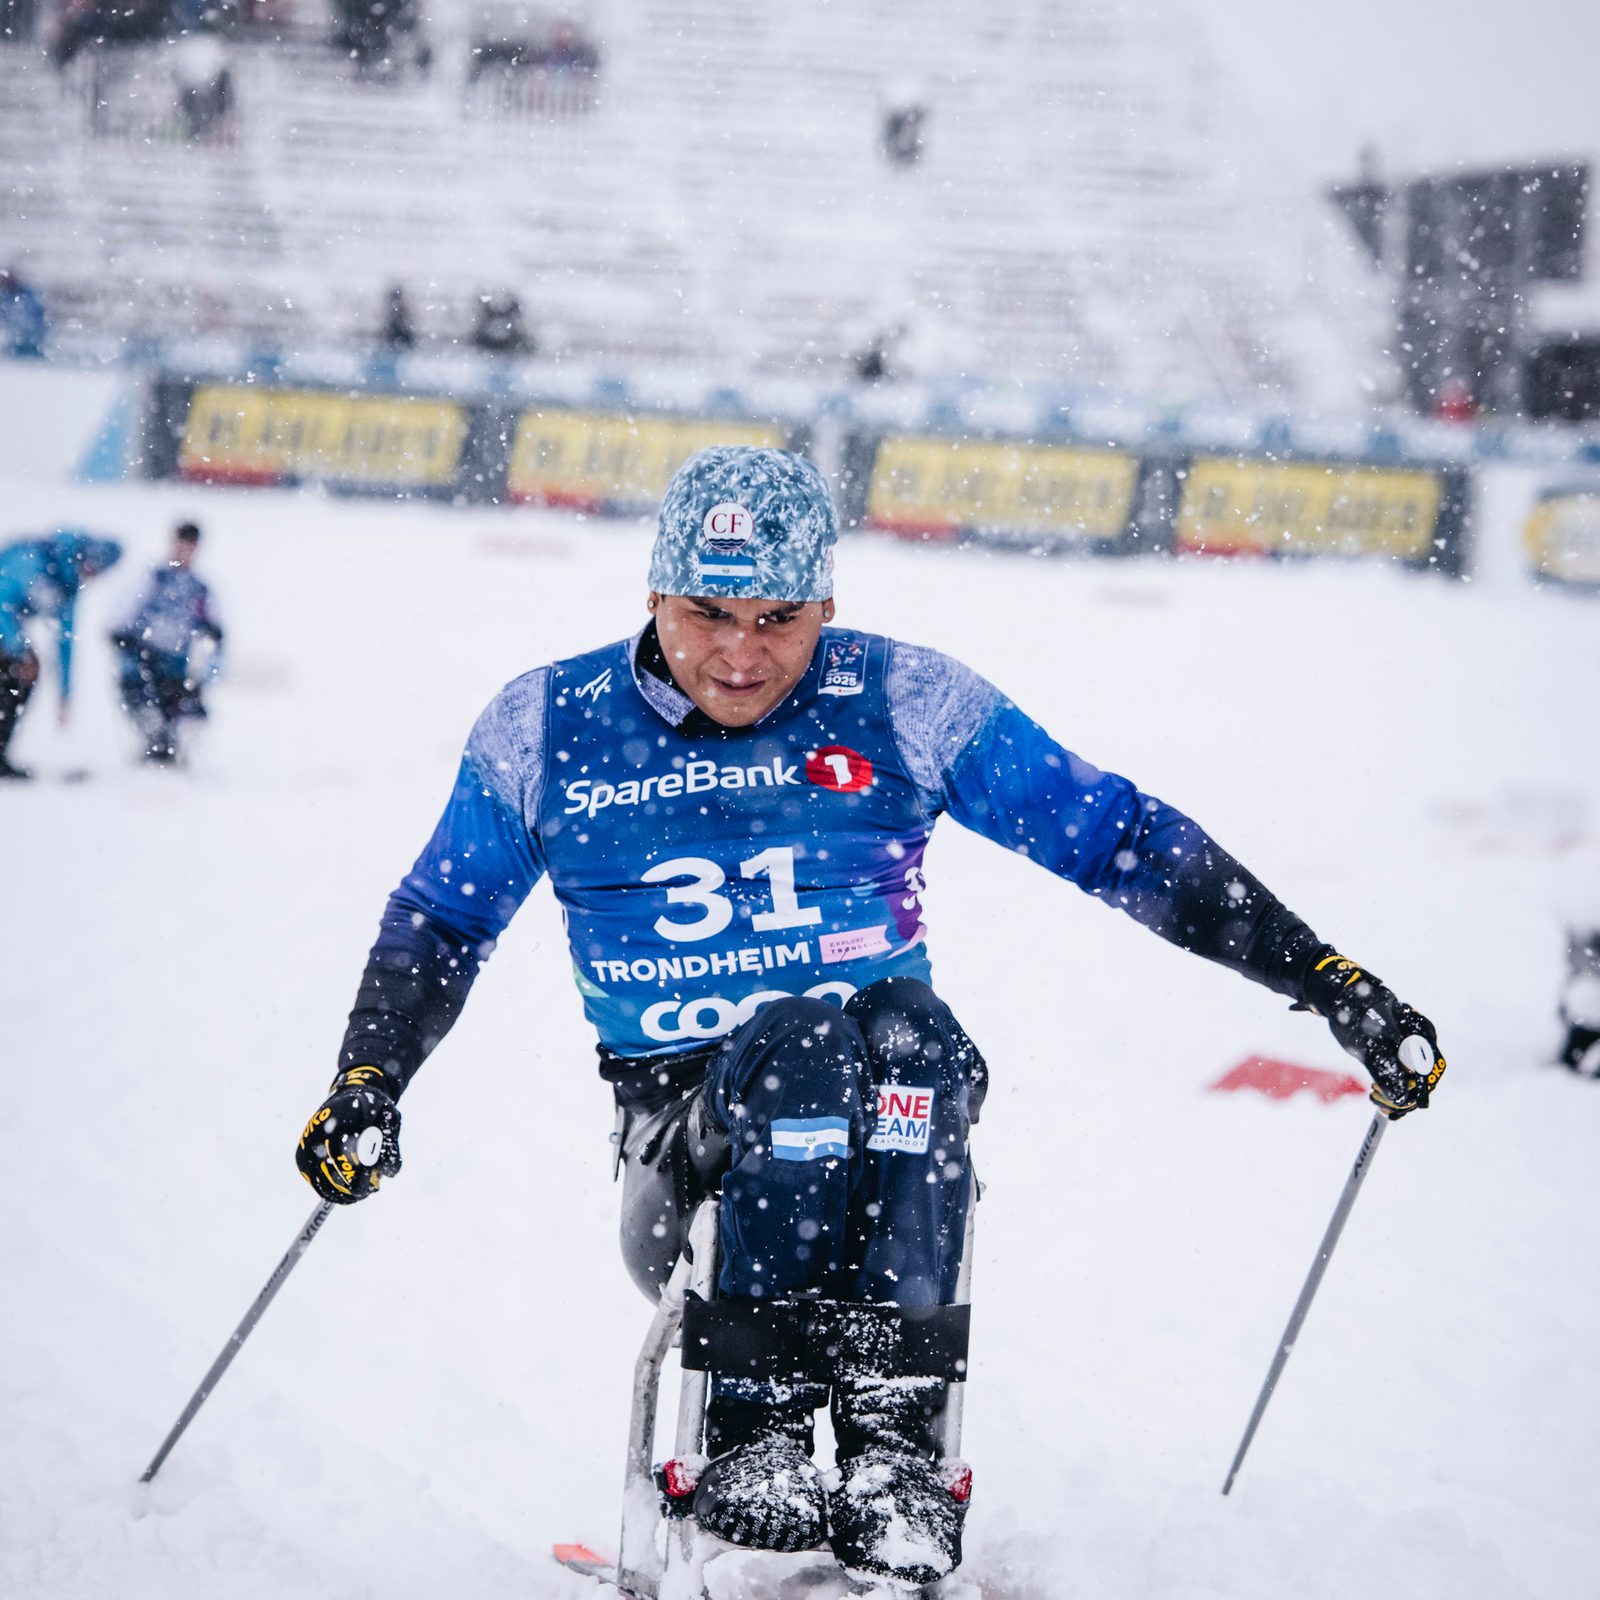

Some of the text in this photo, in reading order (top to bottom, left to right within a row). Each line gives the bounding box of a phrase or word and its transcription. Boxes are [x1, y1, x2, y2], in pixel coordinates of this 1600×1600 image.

[711, 512, 744, 534] CF
[825, 675, 857, 687] 2025
[564, 753, 853, 818] SpareBank 1
[640, 846, 823, 943] 31
[590, 942, 811, 983] TRONDHEIM
[1427, 1058, 1447, 1090] OKO
[877, 1092, 930, 1119] ONE
[875, 1117, 928, 1140] EAM
[873, 1137, 925, 1148] SALVADOR
